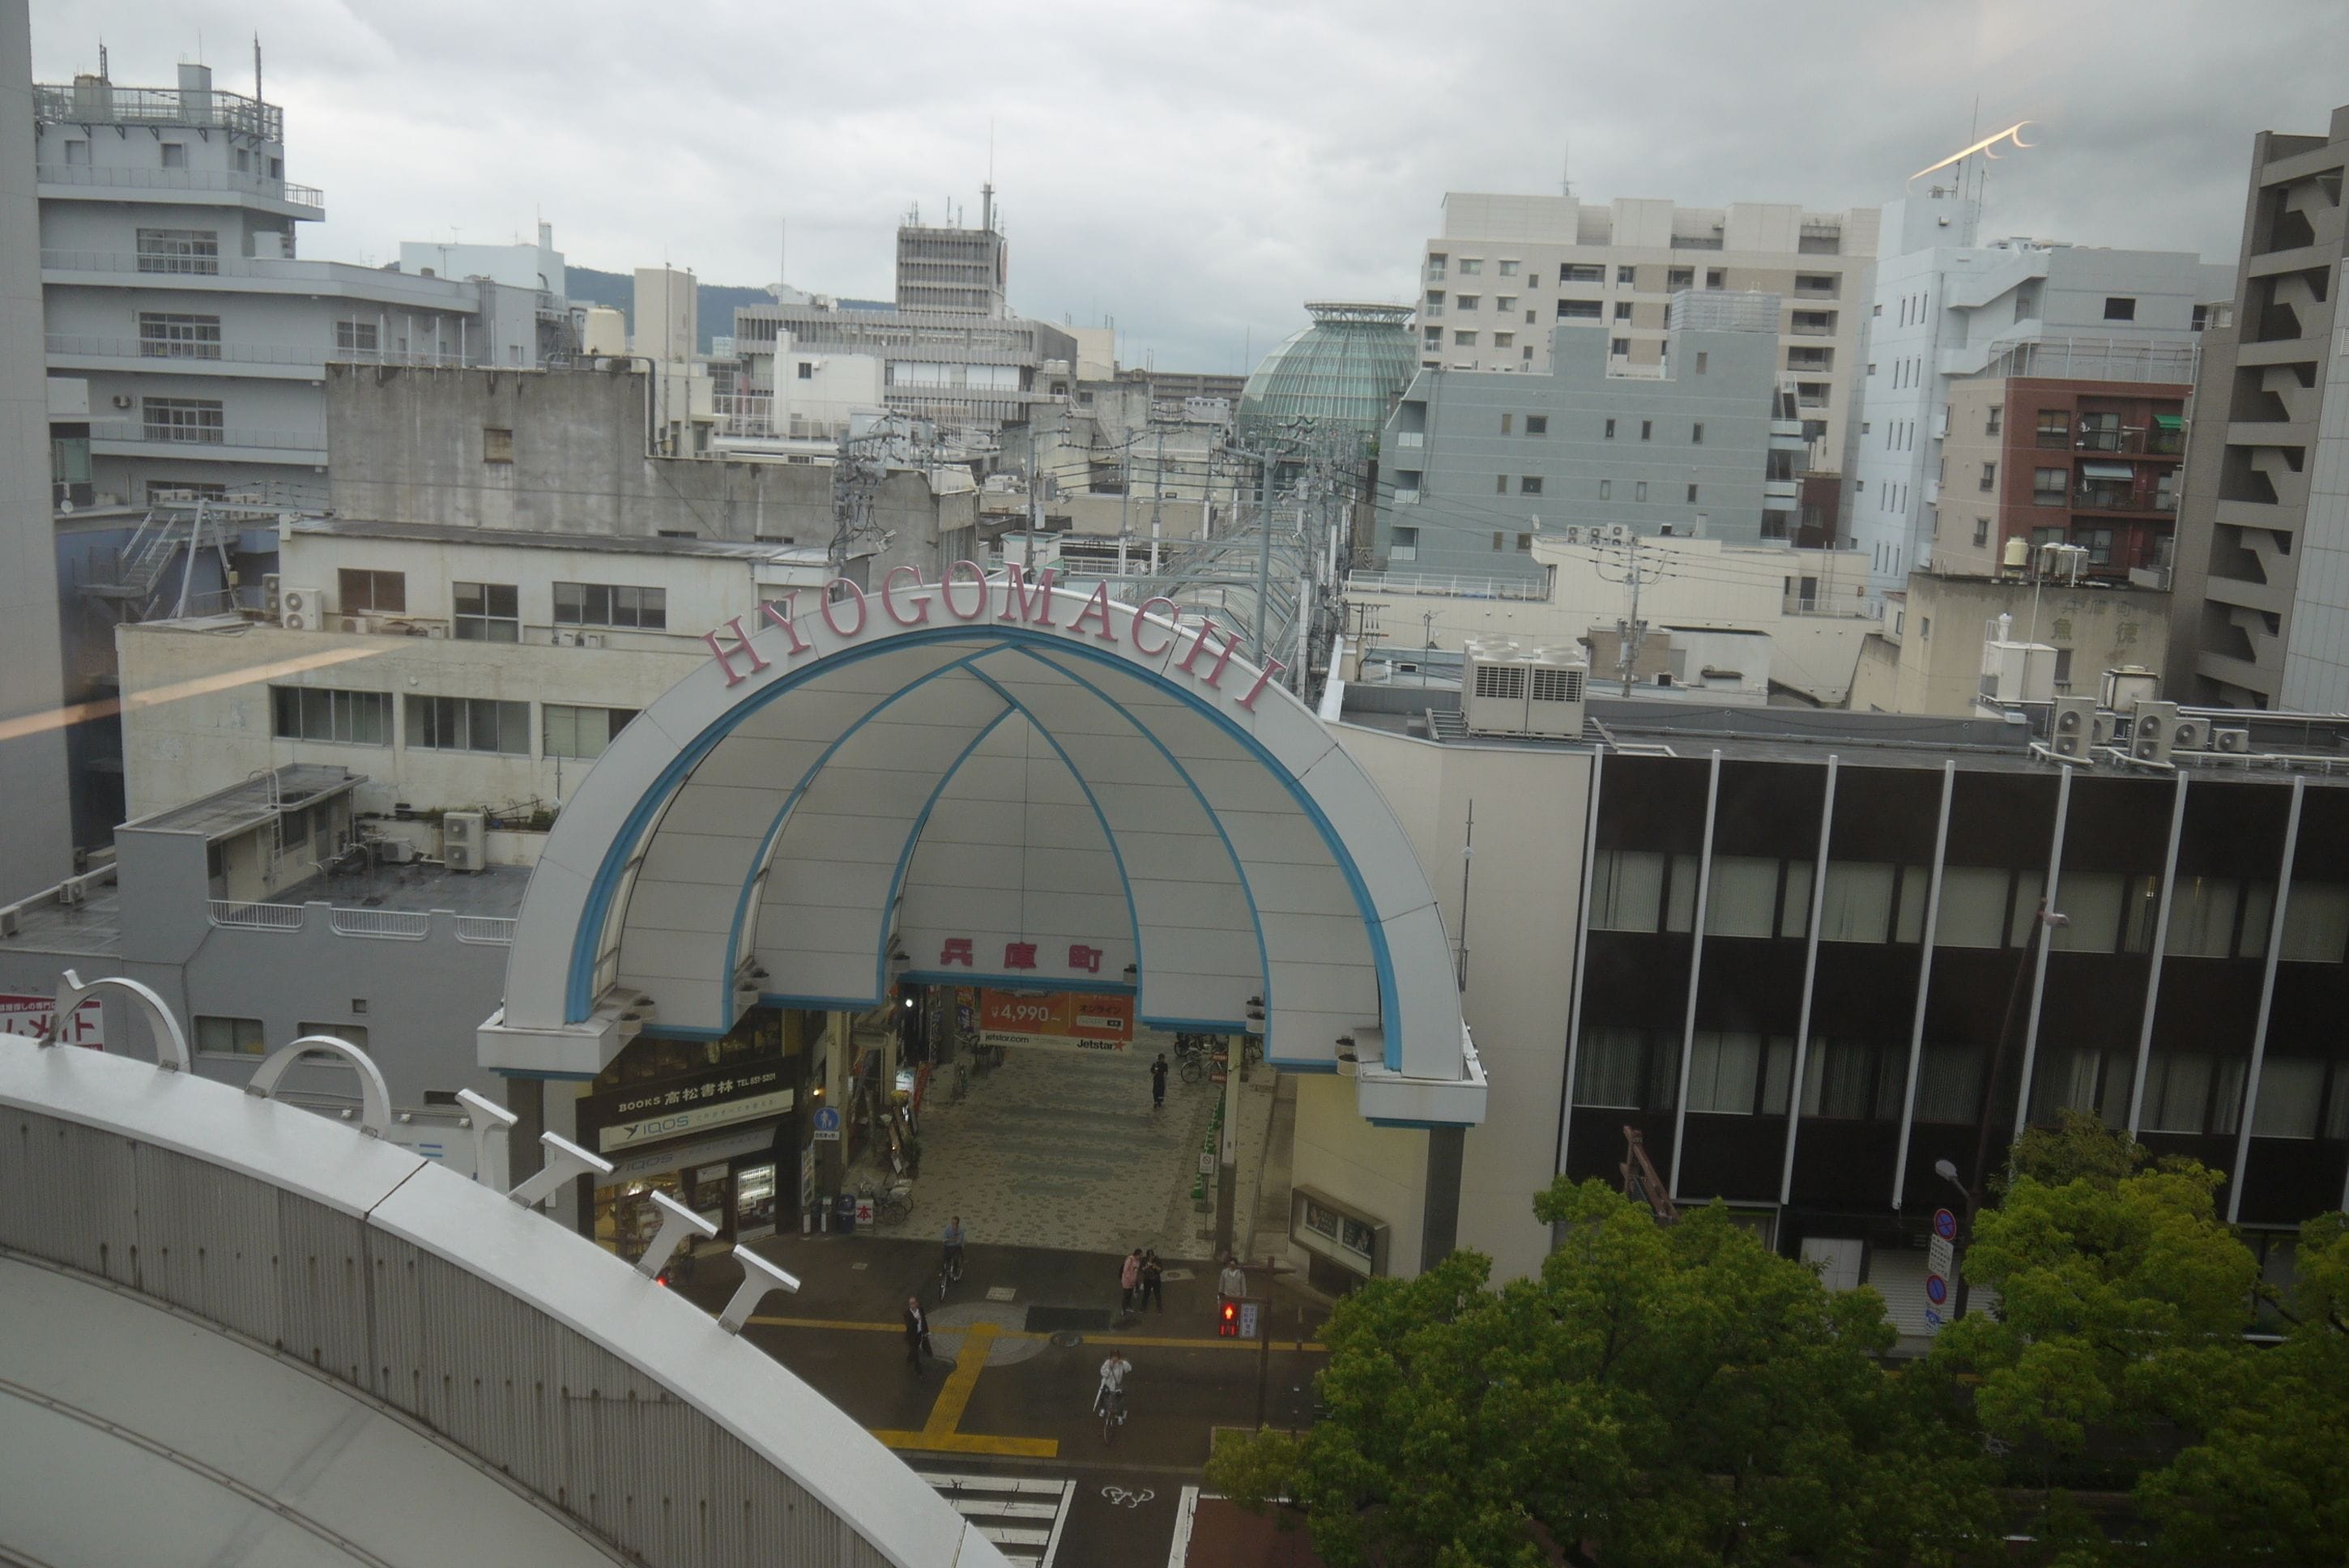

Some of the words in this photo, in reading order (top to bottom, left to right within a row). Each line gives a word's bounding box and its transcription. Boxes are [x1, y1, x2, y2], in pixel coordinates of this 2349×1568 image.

[701, 560, 1285, 712] HYOGOMACHI
[940, 937, 1102, 973] 兵庫町
[985, 1034, 1030, 1044] jetstar.com
[1076, 1039, 1114, 1050] Jetstar
[618, 1097, 661, 1113] BOOKS
[664, 1079, 734, 1106] 高松書林
[736, 1079, 749, 1088] TEL
[643, 1115, 689, 1136] IQOS
[857, 1205, 872, 1221] 本
